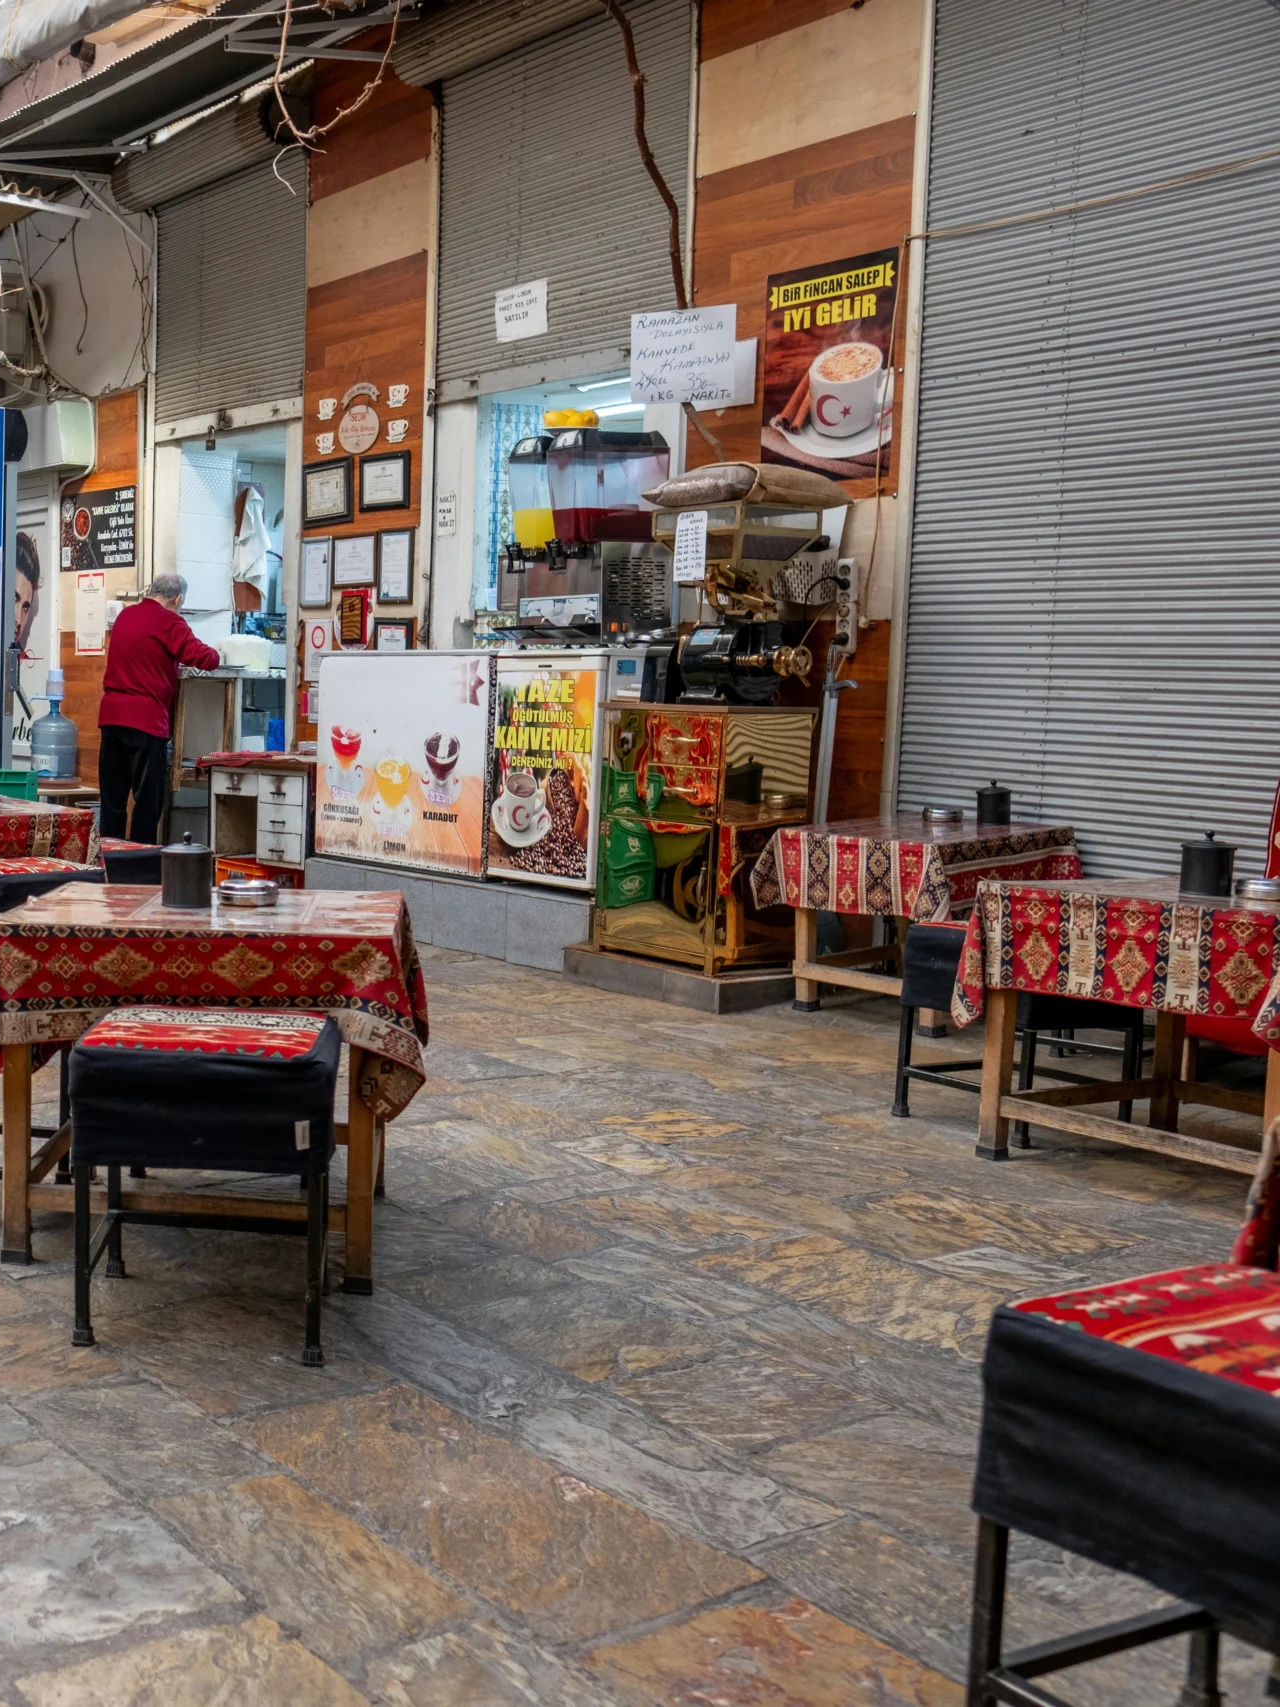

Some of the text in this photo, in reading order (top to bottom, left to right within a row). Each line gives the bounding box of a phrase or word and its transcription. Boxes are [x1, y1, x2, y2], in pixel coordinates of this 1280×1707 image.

[846, 269, 880, 290] SALEP
[504, 311, 529, 324] SATILIR
[636, 312, 700, 329] RAMAZAN
[650, 321, 724, 340] DOLAYISIYLA
[636, 342, 696, 360] KAHVEDE
[660, 352, 730, 374] KAMPANYA
[658, 390, 674, 401] KG
[422, 811, 458, 823] KARADUT
